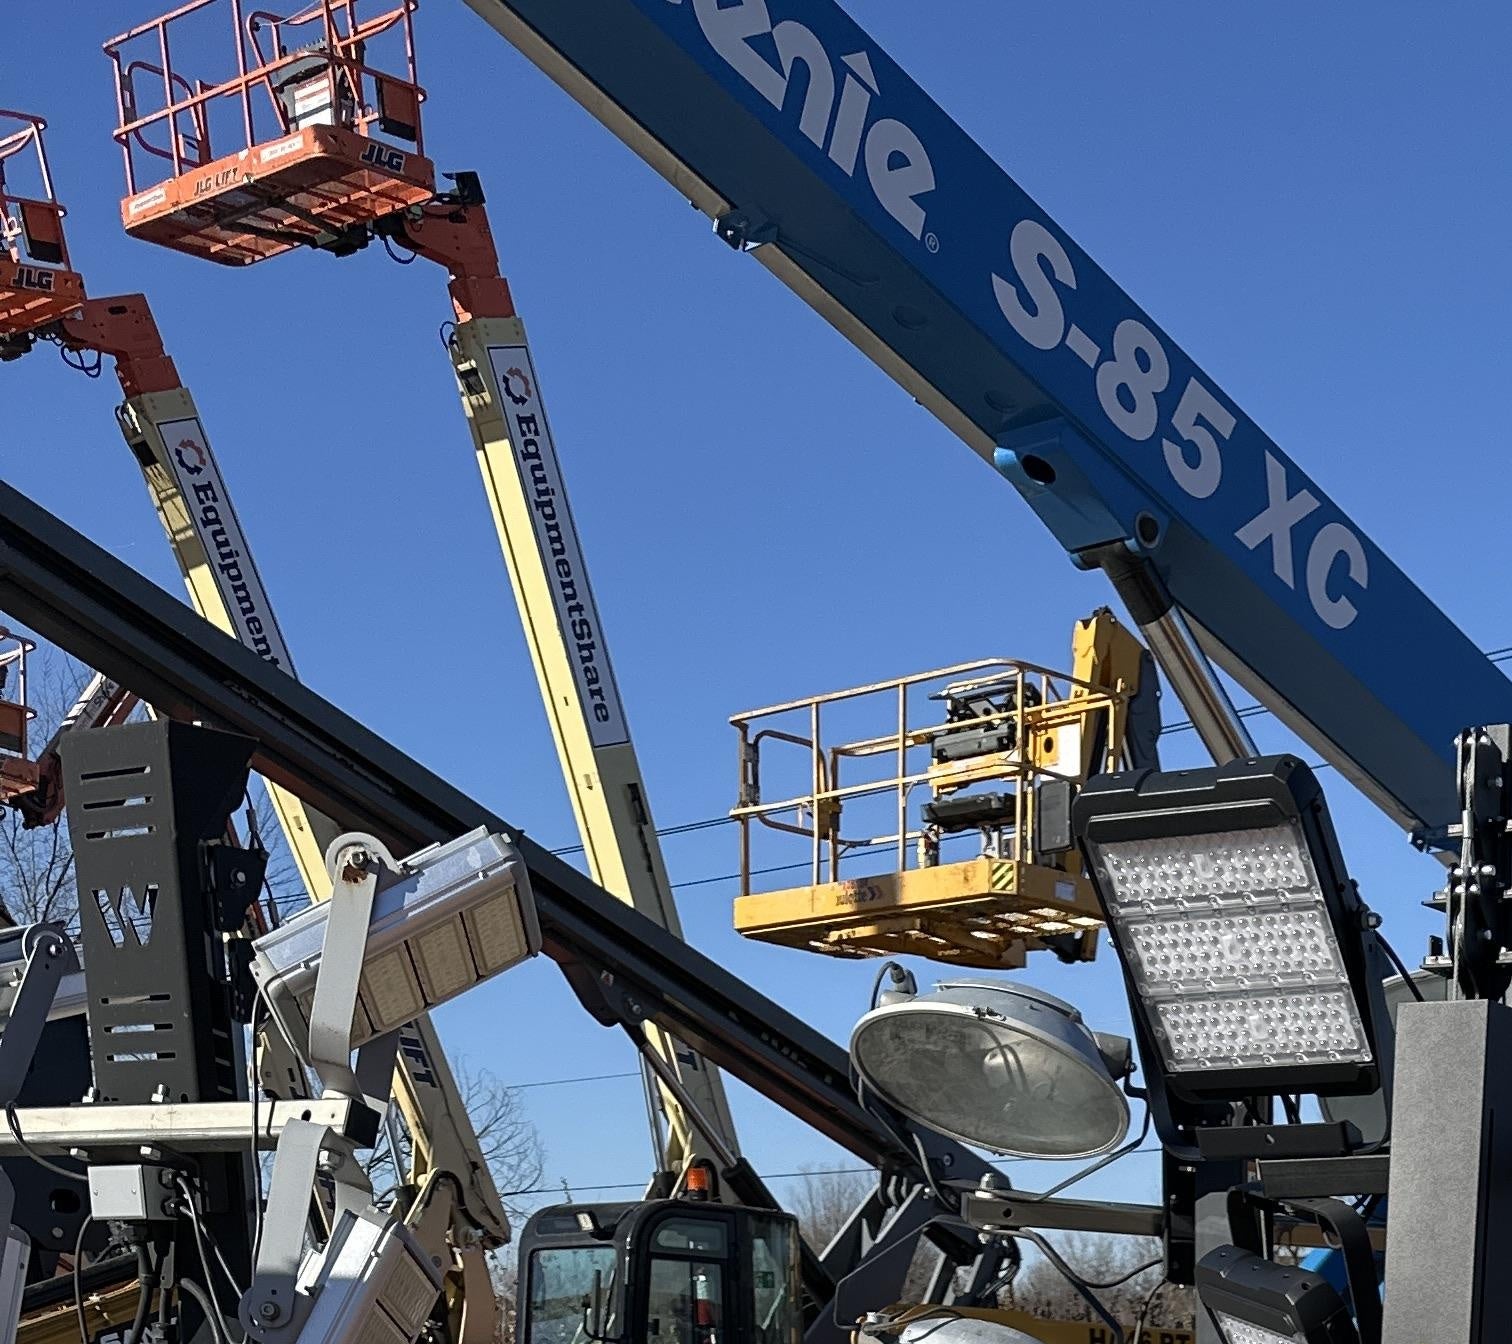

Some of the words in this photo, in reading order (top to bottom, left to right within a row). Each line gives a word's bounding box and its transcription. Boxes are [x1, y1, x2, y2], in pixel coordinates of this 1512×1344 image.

[666, 0, 936, 241] enie
[193, 177, 212, 197] JLG
[361, 143, 405, 173] JLG
[11, 266, 55, 292] JLG
[990, 219, 1237, 500] S-85
[1234, 450, 1370, 630] XC
[515, 412, 610, 724] EquipmentShare
[92, 884, 158, 949] W
